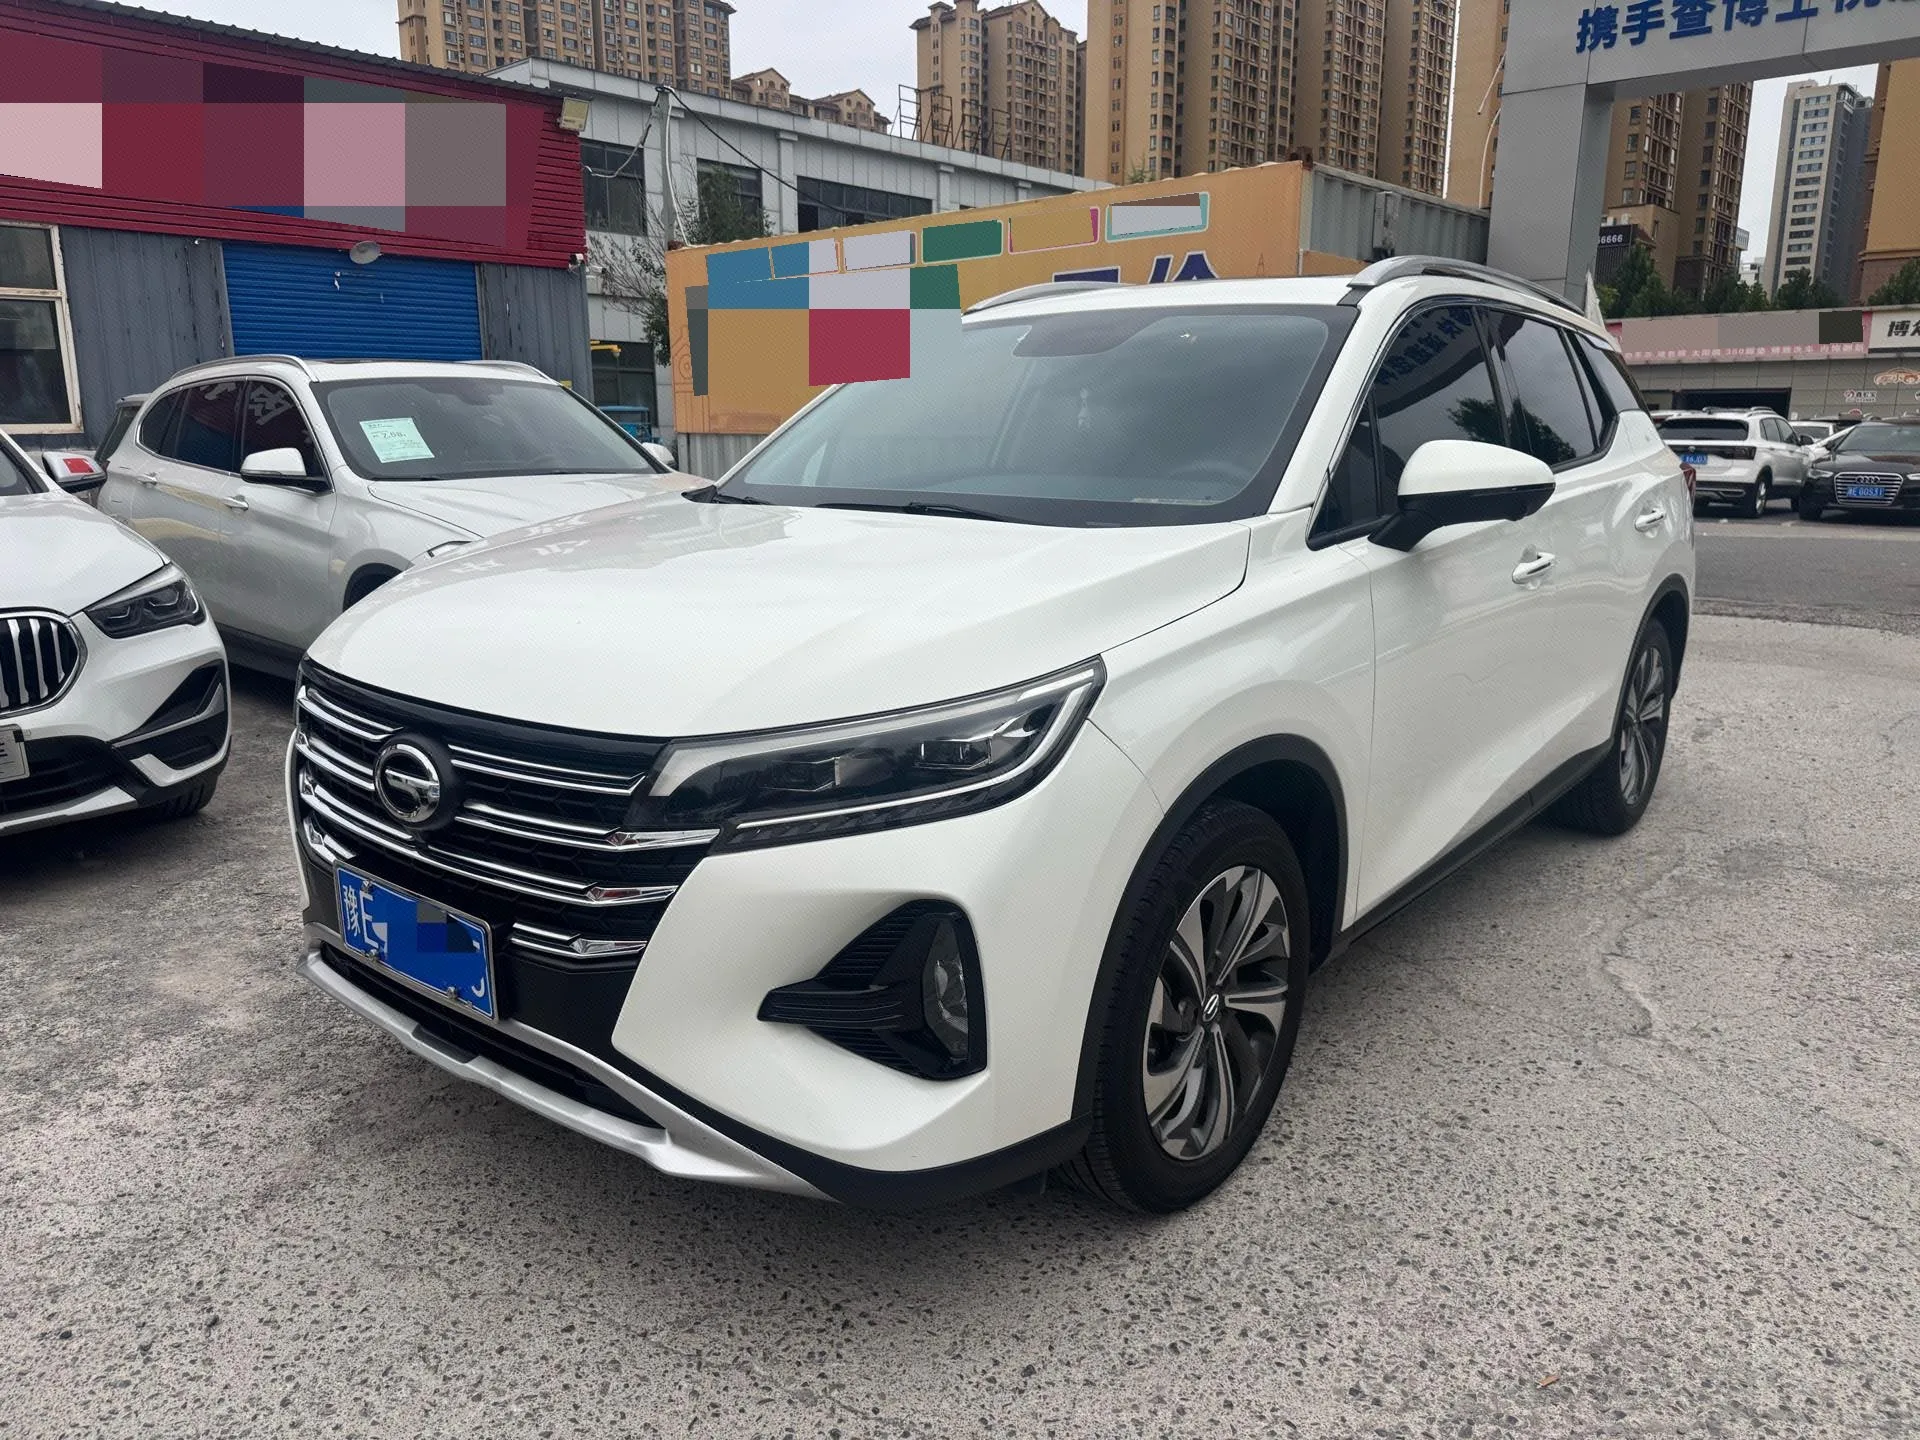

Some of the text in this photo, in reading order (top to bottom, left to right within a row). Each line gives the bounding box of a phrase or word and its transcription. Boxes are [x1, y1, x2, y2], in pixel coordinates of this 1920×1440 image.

[1576, 0, 1919, 53] 携手查博士
